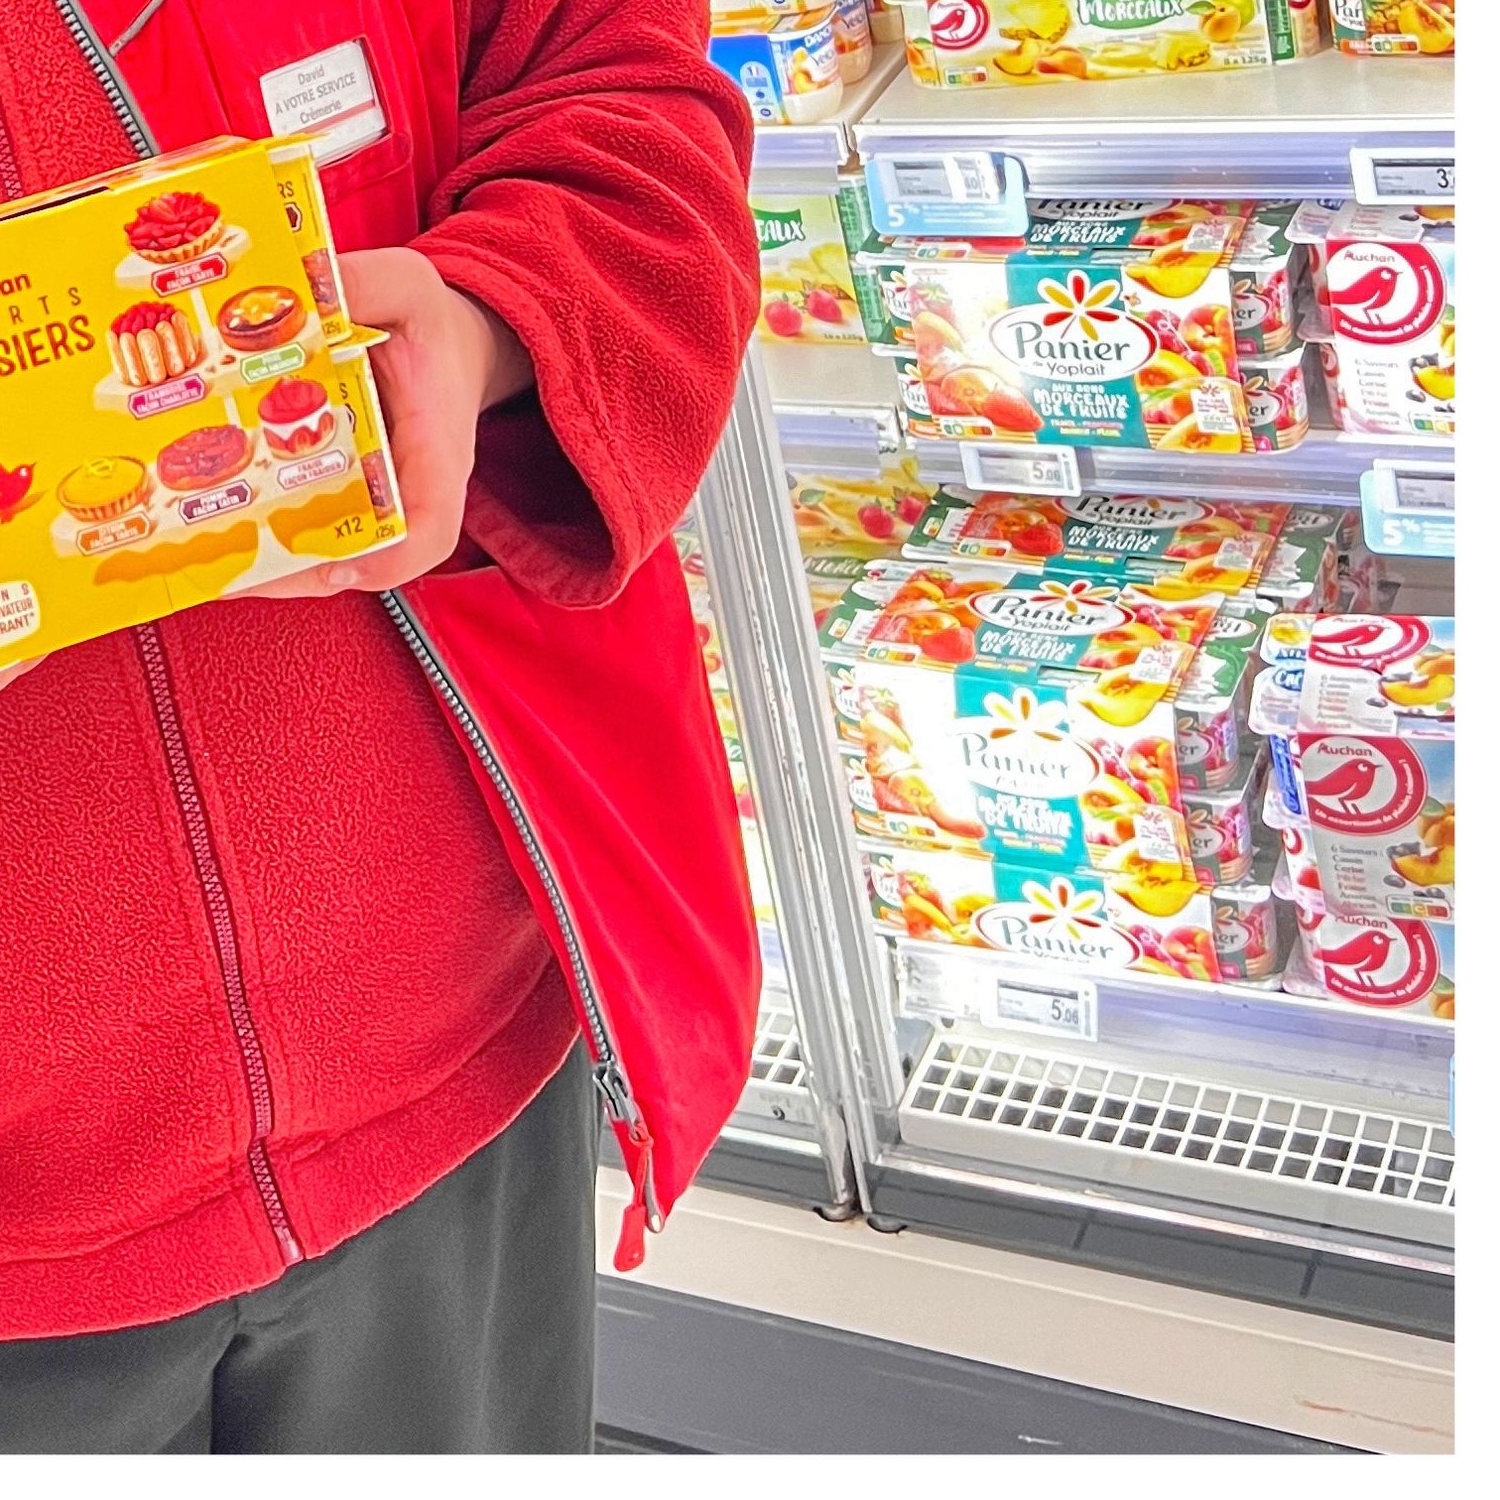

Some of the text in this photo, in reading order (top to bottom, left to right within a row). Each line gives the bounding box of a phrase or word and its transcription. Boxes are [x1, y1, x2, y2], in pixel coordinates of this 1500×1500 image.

[297, 64, 325, 86] David
[283, 88, 315, 112] VOTRE
[316, 72, 357, 98] SERVICE
[1343, 250, 1396, 263] Auchan
[1006, 320, 1130, 361] Panier
[1033, 388, 1129, 408] MORCEAUX
[334, 515, 364, 540] x12
[989, 596, 1105, 627] Panier
[1317, 743, 1373, 756] Auchan
[1335, 914, 1389, 930] Auchan
[993, 916, 1114, 957] Panier
